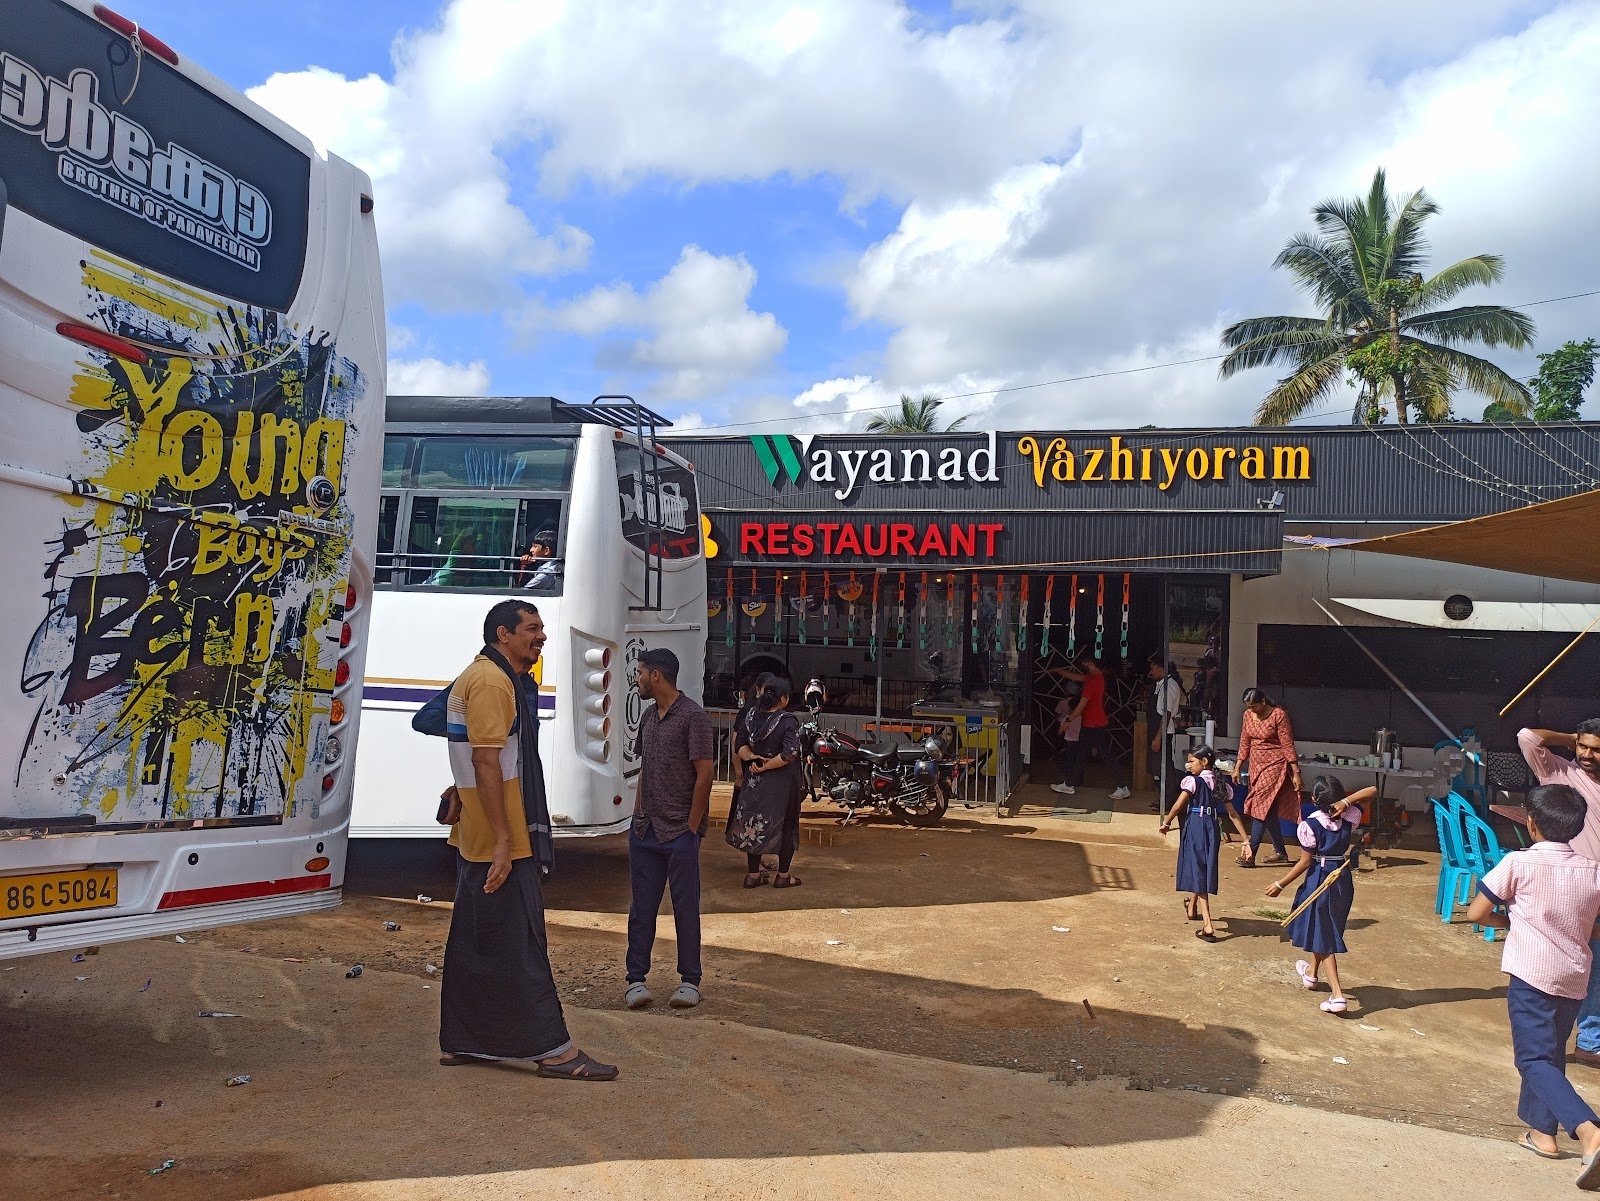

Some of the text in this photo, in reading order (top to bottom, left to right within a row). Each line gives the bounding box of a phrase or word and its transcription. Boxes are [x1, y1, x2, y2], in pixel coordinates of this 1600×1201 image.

[62, 160, 256, 266] BROTHER OF PADAVEEDAN
[115, 357, 347, 519] Young
[750, 430, 1311, 500] Wayanad Vazhiyoram
[192, 511, 315, 583] Boys
[741, 523, 1004, 557] RESTAURANT
